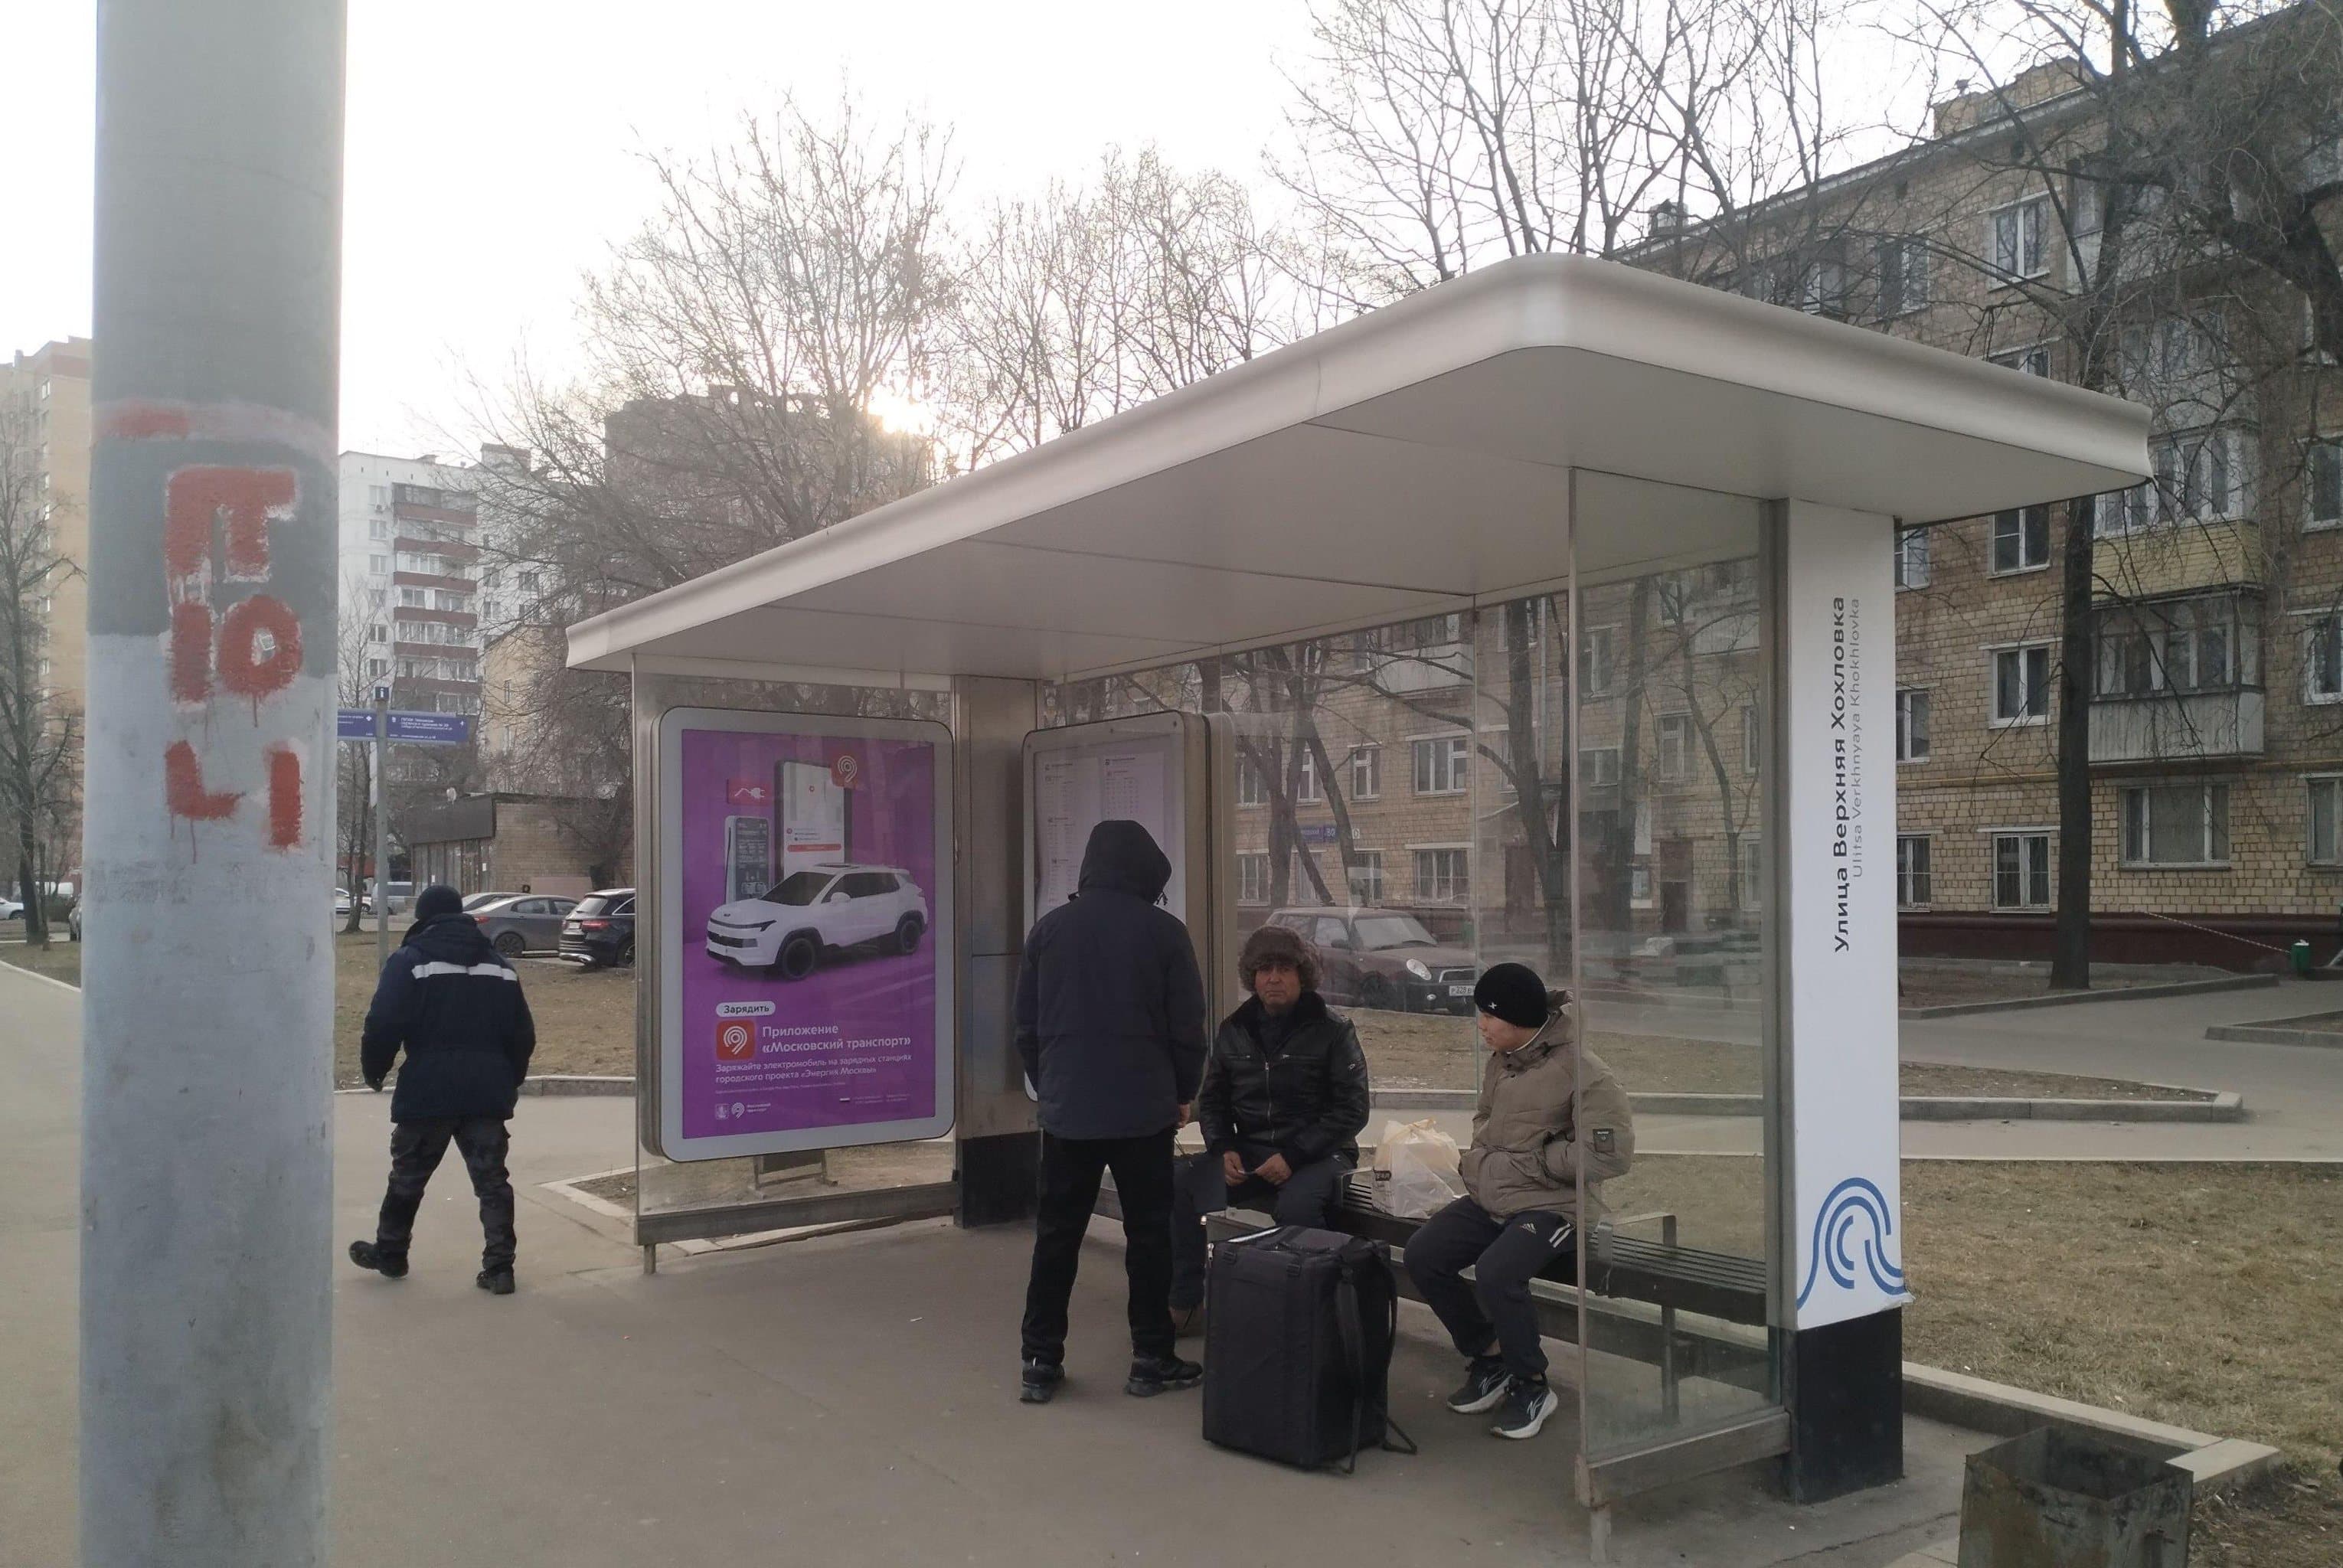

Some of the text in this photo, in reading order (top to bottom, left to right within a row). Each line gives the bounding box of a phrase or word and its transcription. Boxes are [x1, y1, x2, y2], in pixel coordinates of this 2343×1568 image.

[1849, 599, 1863, 877] Ulitsa Verkhnyaya Khokhlovka
[1831, 597, 1850, 952] Улица Верхняя Хохловка
[723, 1004, 770, 1014] Зарядить
[762, 1024, 839, 1039] Приложение
[761, 1036, 912, 1053] «Московский транспорт»
[715, 1063, 762, 1073] Заряжайте
[763, 1058, 828, 1070] электромобиль
[877, 1054, 913, 1063] станциях
[715, 1073, 763, 1084] городского
[765, 1071, 799, 1082] проекта
